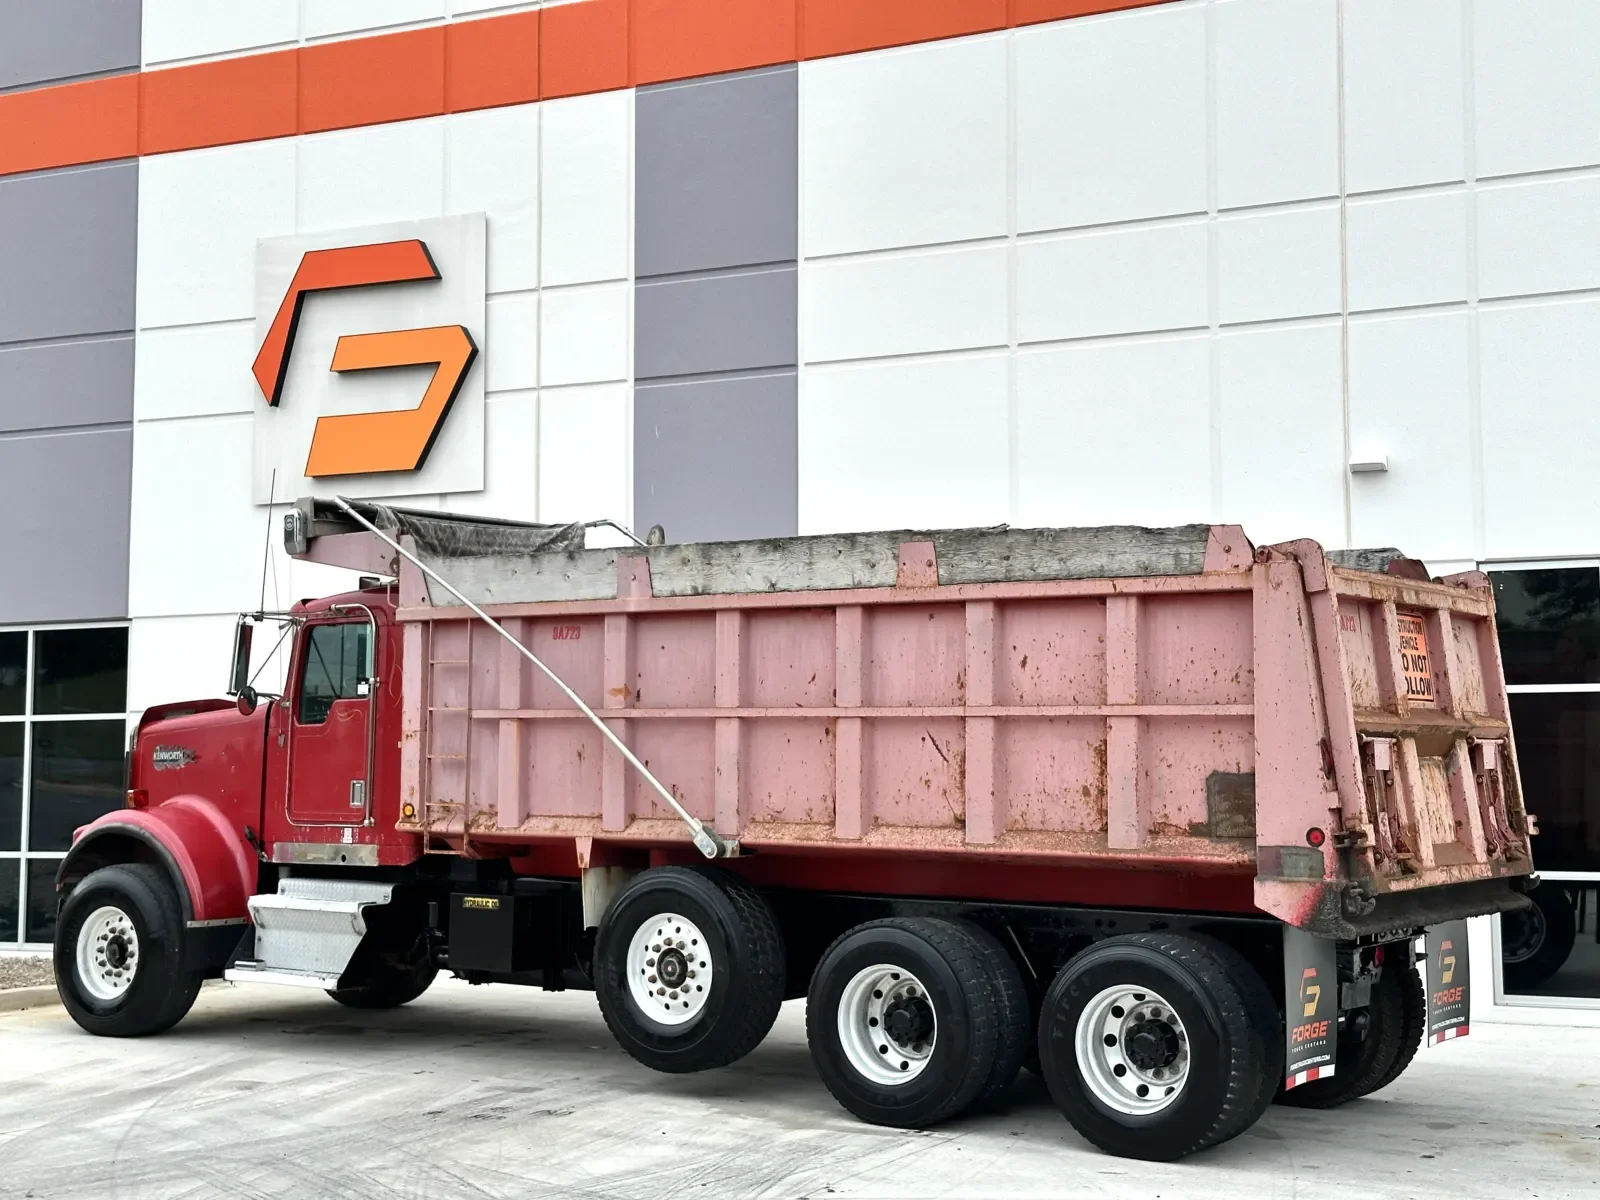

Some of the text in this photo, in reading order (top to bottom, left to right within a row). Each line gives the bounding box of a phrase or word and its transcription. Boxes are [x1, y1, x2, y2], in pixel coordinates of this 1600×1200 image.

[1397, 619, 1424, 635] STRUCTION
[1401, 653, 1428, 673] O NOT
[1404, 676, 1432, 696] OLLOW
[153, 751, 184, 760] KENWORTH
[1432, 986, 1463, 1007] FORGE
[1291, 1020, 1328, 1044] FORGE
